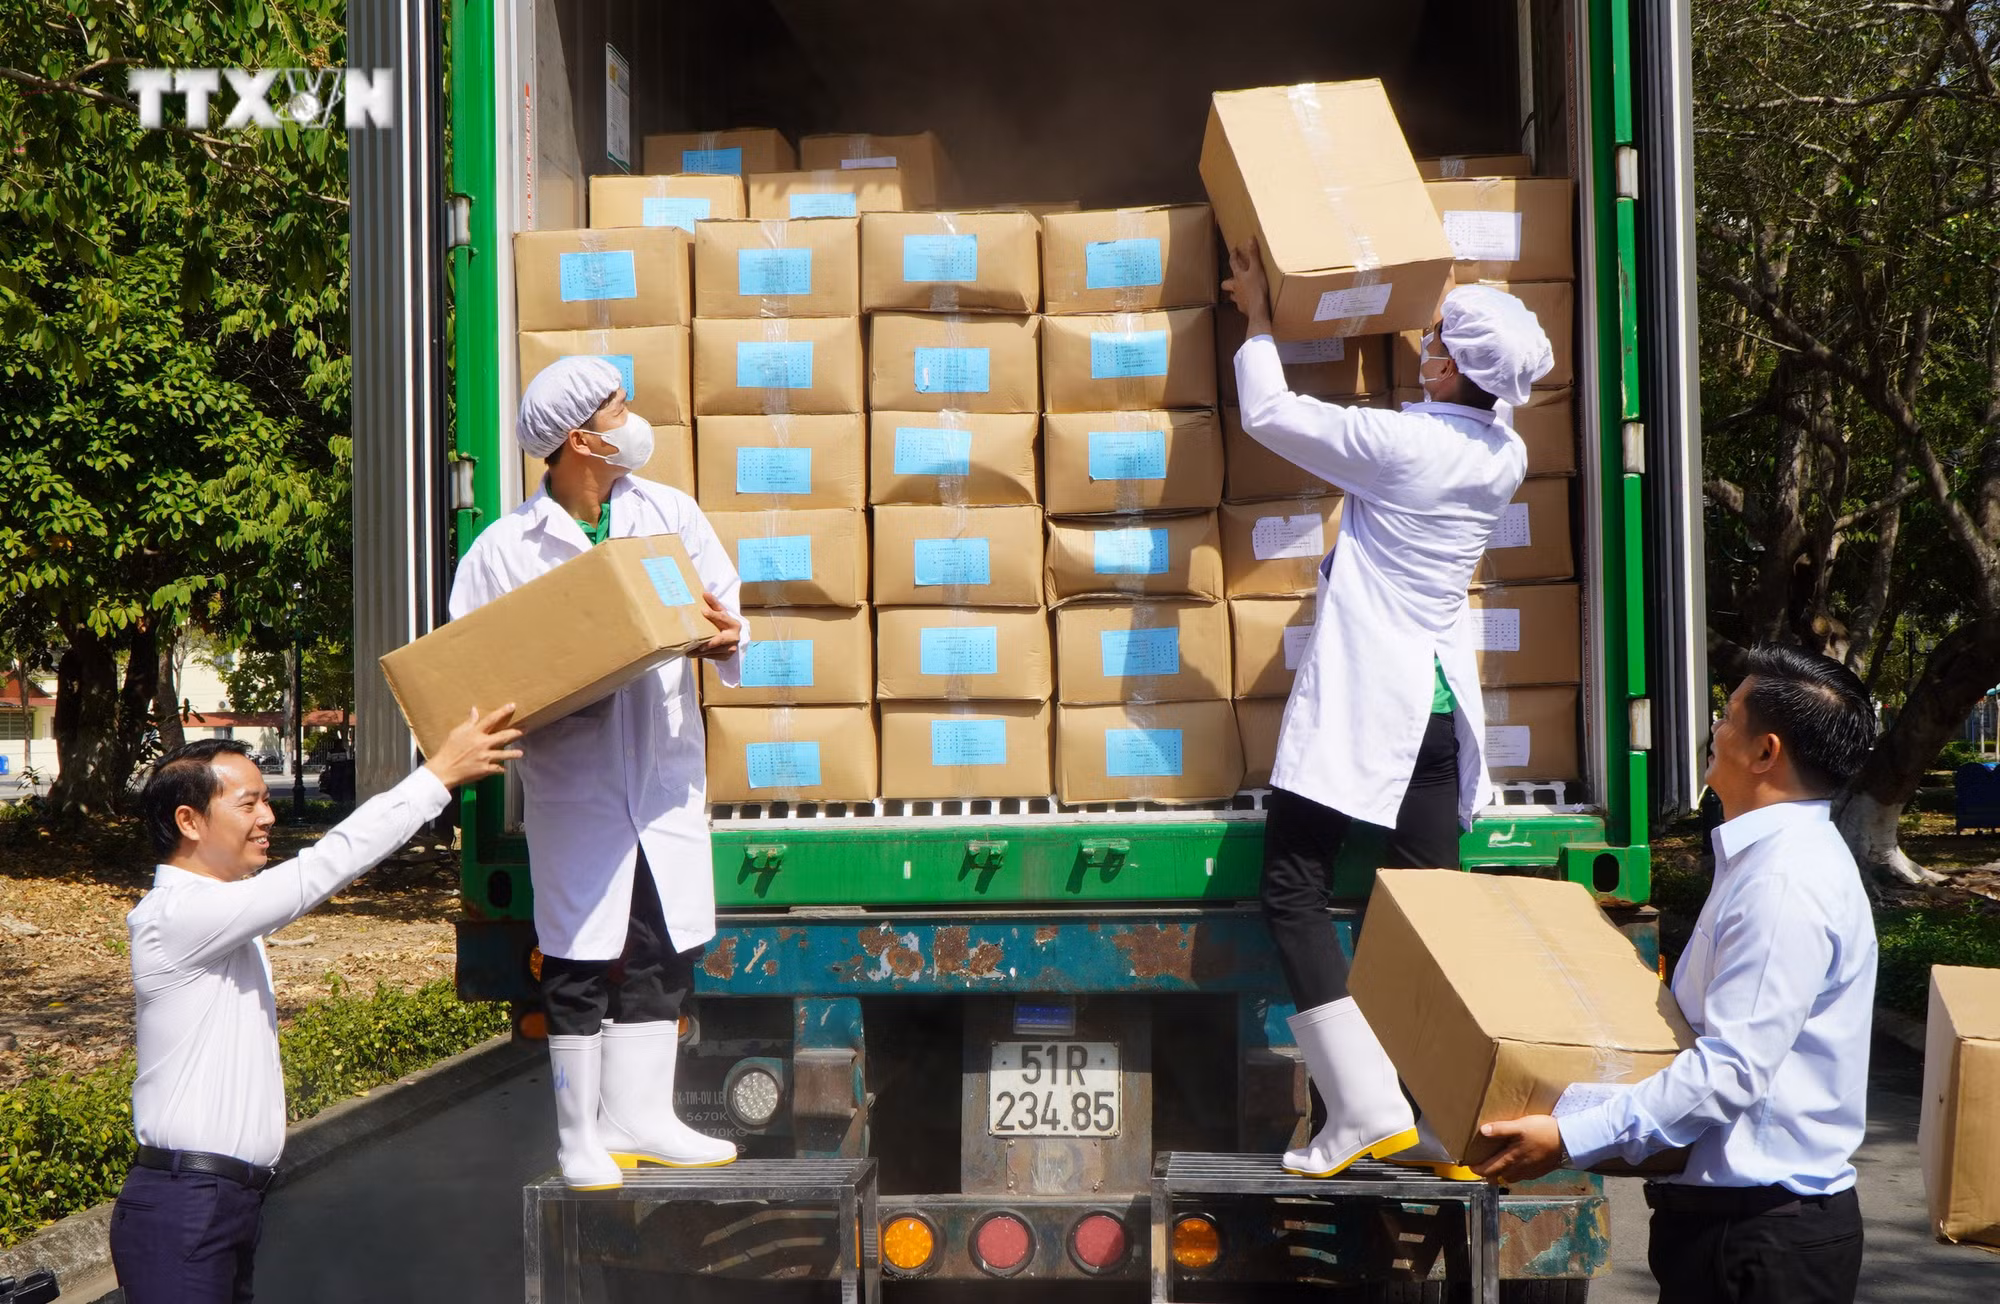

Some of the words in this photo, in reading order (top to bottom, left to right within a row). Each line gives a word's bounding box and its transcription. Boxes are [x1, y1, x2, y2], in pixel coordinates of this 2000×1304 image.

[1021, 1045, 1088, 1085] 51R
[996, 1091, 1114, 1131] 234.85
[696, 1128, 749, 1138] 170KG
